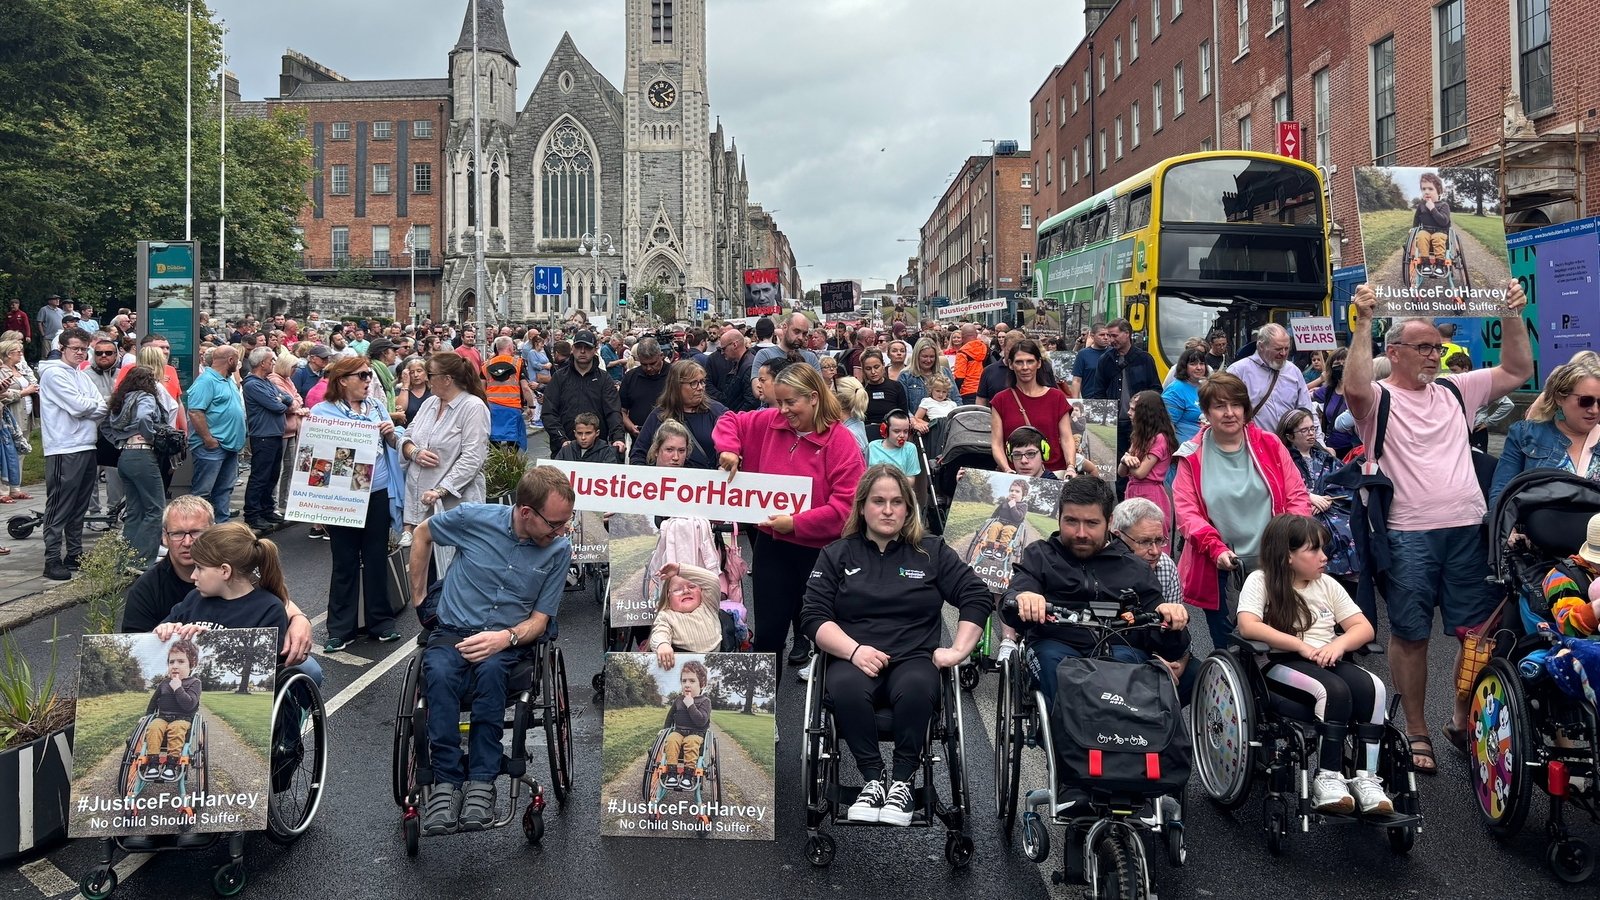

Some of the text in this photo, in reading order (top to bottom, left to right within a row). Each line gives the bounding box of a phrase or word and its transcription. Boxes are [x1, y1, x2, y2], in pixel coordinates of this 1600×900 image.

[822, 282, 852, 294] JUSTICE
[1375, 286, 1507, 300] #JusticeForHarvey
[824, 299, 852, 311] HARVEY
[940, 301, 1005, 315] #JusticeForHarvey
[1388, 302, 1500, 311] No Child Should Suffer.
[1295, 333, 1334, 343] YEARS
[306, 415, 377, 430] #BringHarryHome
[306, 433, 352, 442] CONSTITUTIONAL
[308, 492, 333, 500] Parental
[570, 471, 807, 516] JusticeForHarvey
[314, 503, 343, 511] in-camera
[288, 510, 363, 525] #BringHarryHome
[78, 791, 259, 812] #JusticeForHarvey
[608, 799, 766, 820] #JusticeForHarvey
[91, 812, 243, 829] No Child Should Suffer.
[620, 819, 753, 833] No Child Should Suffer.
